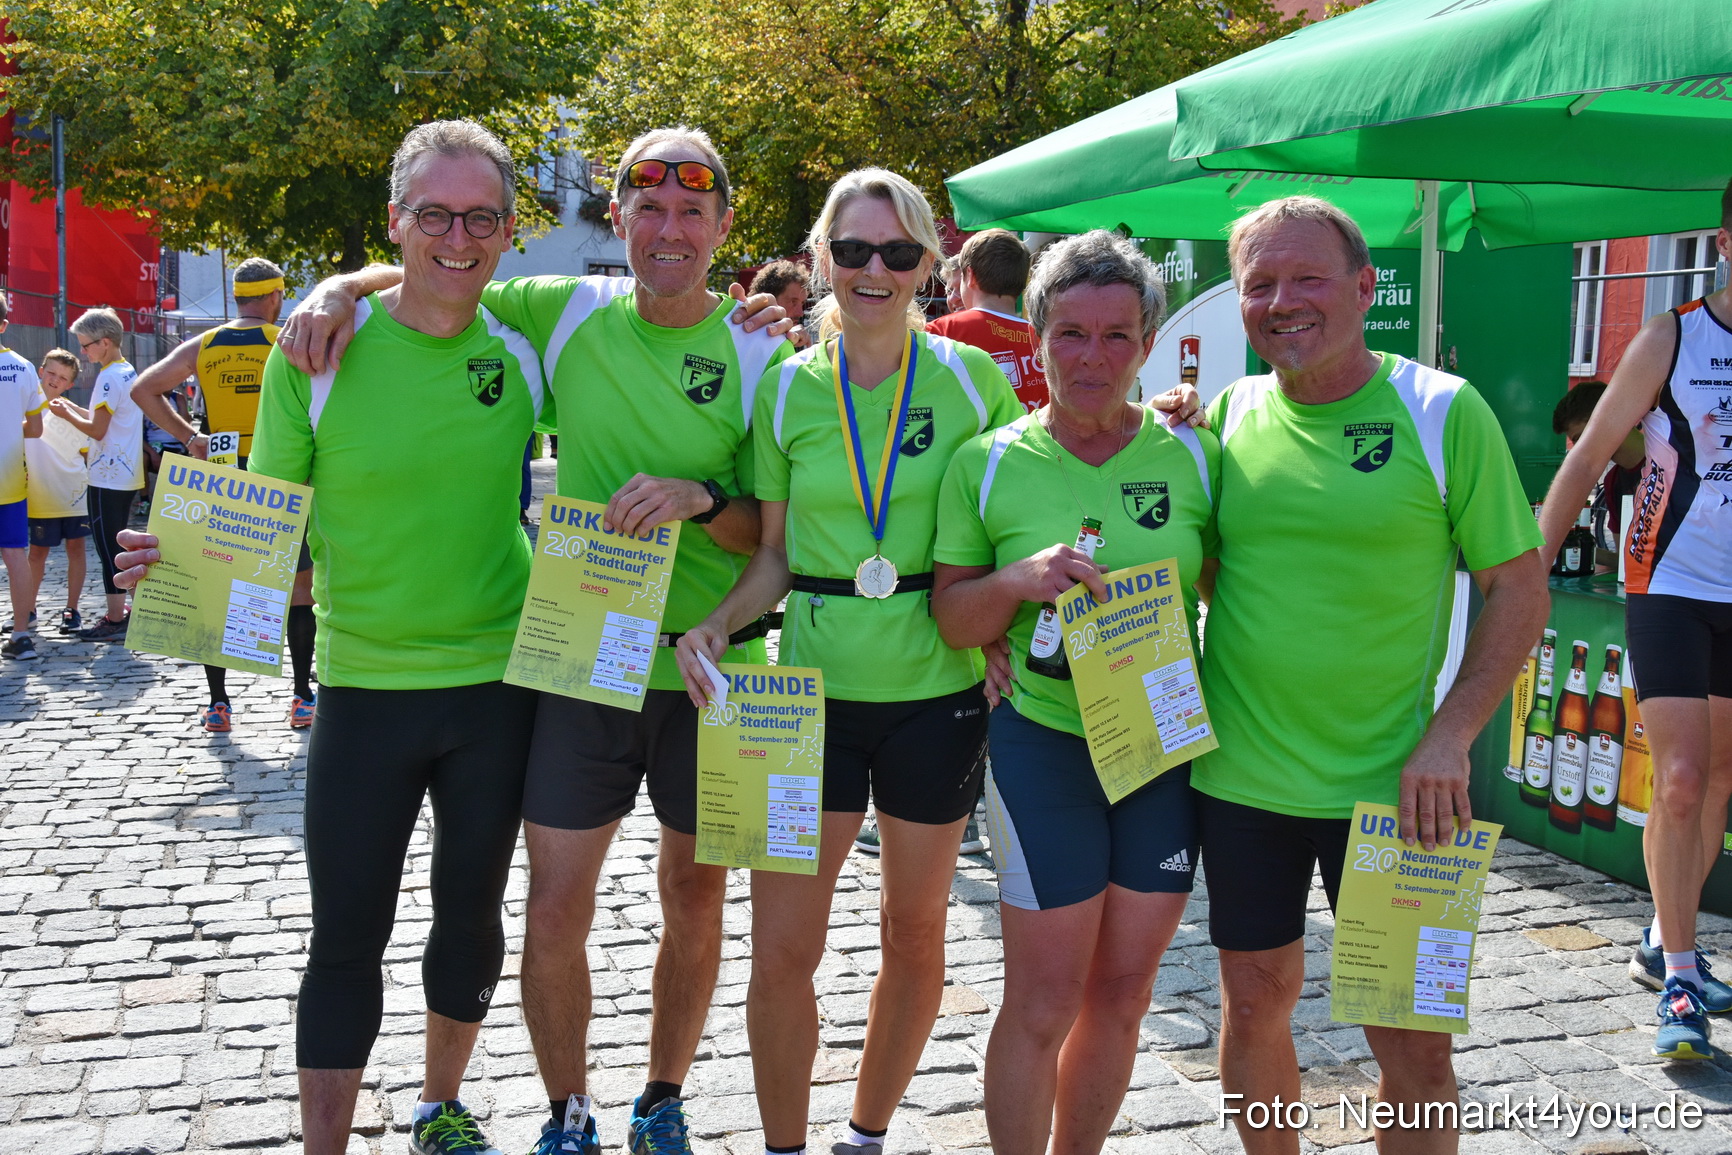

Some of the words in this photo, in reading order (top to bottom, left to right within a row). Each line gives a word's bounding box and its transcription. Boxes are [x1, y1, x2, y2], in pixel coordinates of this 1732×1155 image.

[1148, 250, 1198, 283] affen.
[1371, 284, 1411, 306] räu
[1362, 317, 1410, 330] raeu.de
[986, 320, 1030, 343] Team
[0, 364, 26, 372] arkter
[220, 372, 254, 384] Team
[1346, 423, 1392, 431] EZELSDORF
[166, 464, 302, 515] URKUNDE
[210, 503, 296, 534] Neumarkter
[548, 504, 671, 546] URKE
[206, 517, 277, 545] Stadtlauf
[203, 535, 213, 543] 15.
[214, 538, 252, 553] September
[253, 547, 270, 556] 2019
[588, 539, 666, 565] Neumarkter
[202, 548, 225, 559] DKMS
[584, 552, 648, 577] Stadtlauf
[591, 571, 626, 585] September
[627, 579, 642, 587] 2019
[580, 582, 602, 593] DKMS
[1096, 594, 1173, 629] Neumarkter
[1100, 610, 1159, 643] Stadtlauf
[1105, 649, 1113, 657] 15.
[1112, 635, 1145, 656] September
[1145, 630, 1160, 642] 2019
[224, 646, 242, 654] PARTL
[242, 650, 267, 660] Neumarkt
[1109, 657, 1127, 672] DKMS
[592, 678, 608, 686] PARTL
[608, 682, 631, 691] Neumarkt
[722, 672, 816, 698] RKUNDE
[740, 701, 817, 718] Neumarkter
[1520, 678, 1529, 727] Lammsbräu
[964, 708, 980, 717] JAKO
[739, 714, 802, 731] Stadtlauf
[748, 734, 782, 744] September
[784, 736, 798, 744] 2019
[1164, 738, 1180, 750] PARTL
[1180, 730, 1200, 744] Neumarkt
[739, 748, 759, 756] DKMS
[1560, 750, 1580, 759] Neumarkter
[1593, 750, 1614, 760] Neumarkter
[1625, 743, 1650, 756] Lammsbräu
[1556, 756, 1583, 769] Lammsbräu
[1590, 755, 1616, 769] Lammsbräu
[780, 776, 805, 784] BOCK
[1557, 765, 1581, 781] Urstoff
[1590, 767, 1613, 781] Zwickl
[1359, 812, 1490, 853] URDE
[1160, 858, 1191, 872] adidas
[1400, 849, 1482, 872] Neumarkter
[1397, 861, 1462, 884] Stadtlauf
[1403, 884, 1440, 896] September
[1440, 888, 1455, 896] 2019
[1391, 897, 1414, 907] DKMS
[1432, 930, 1458, 939] BOCK
